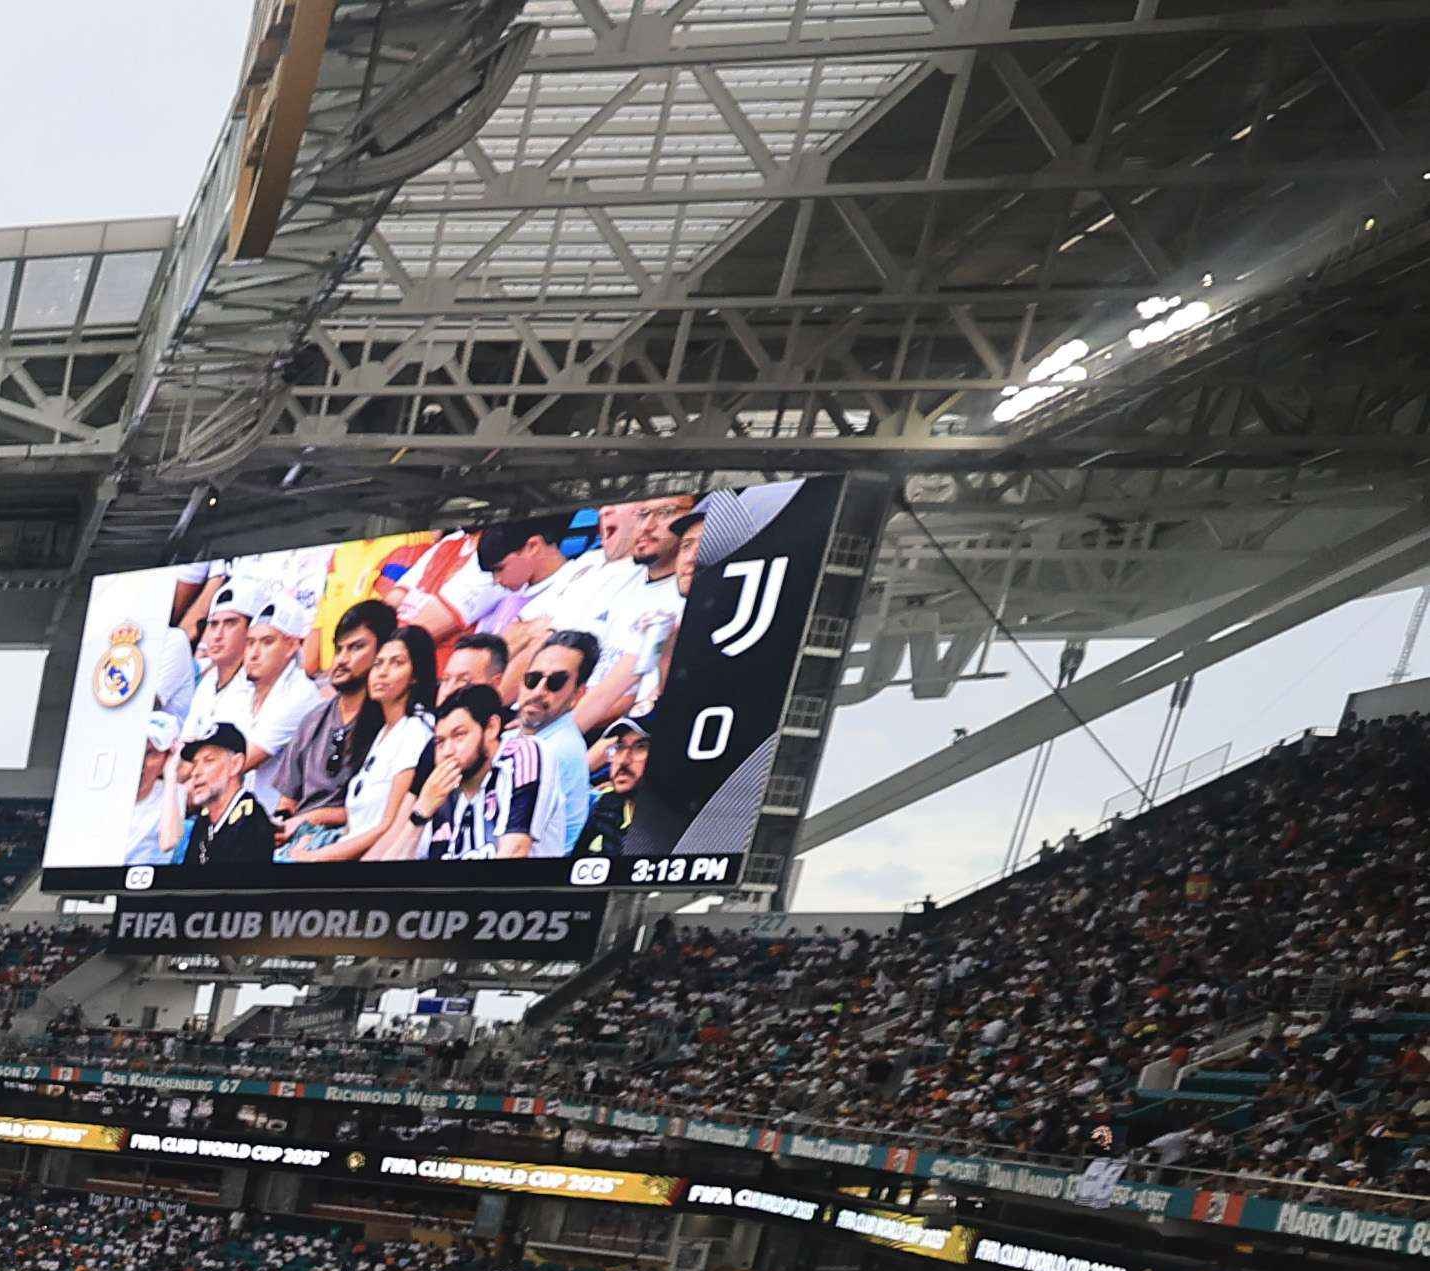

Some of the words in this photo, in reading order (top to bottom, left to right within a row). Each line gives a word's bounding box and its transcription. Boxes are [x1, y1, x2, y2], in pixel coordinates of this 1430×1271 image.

[687, 705, 734, 760] 0
[630, 858, 687, 882] 3:13
[689, 857, 729, 881] PM
[117, 911, 178, 938] FIFA
[183, 910, 263, 939] CLUB
[270, 909, 390, 940] WORLD
[396, 910, 470, 941] CUP
[455, 1095, 477, 1110] 78
[1275, 1201, 1335, 1241] MARK
[1334, 1210, 1406, 1251] DUPER
